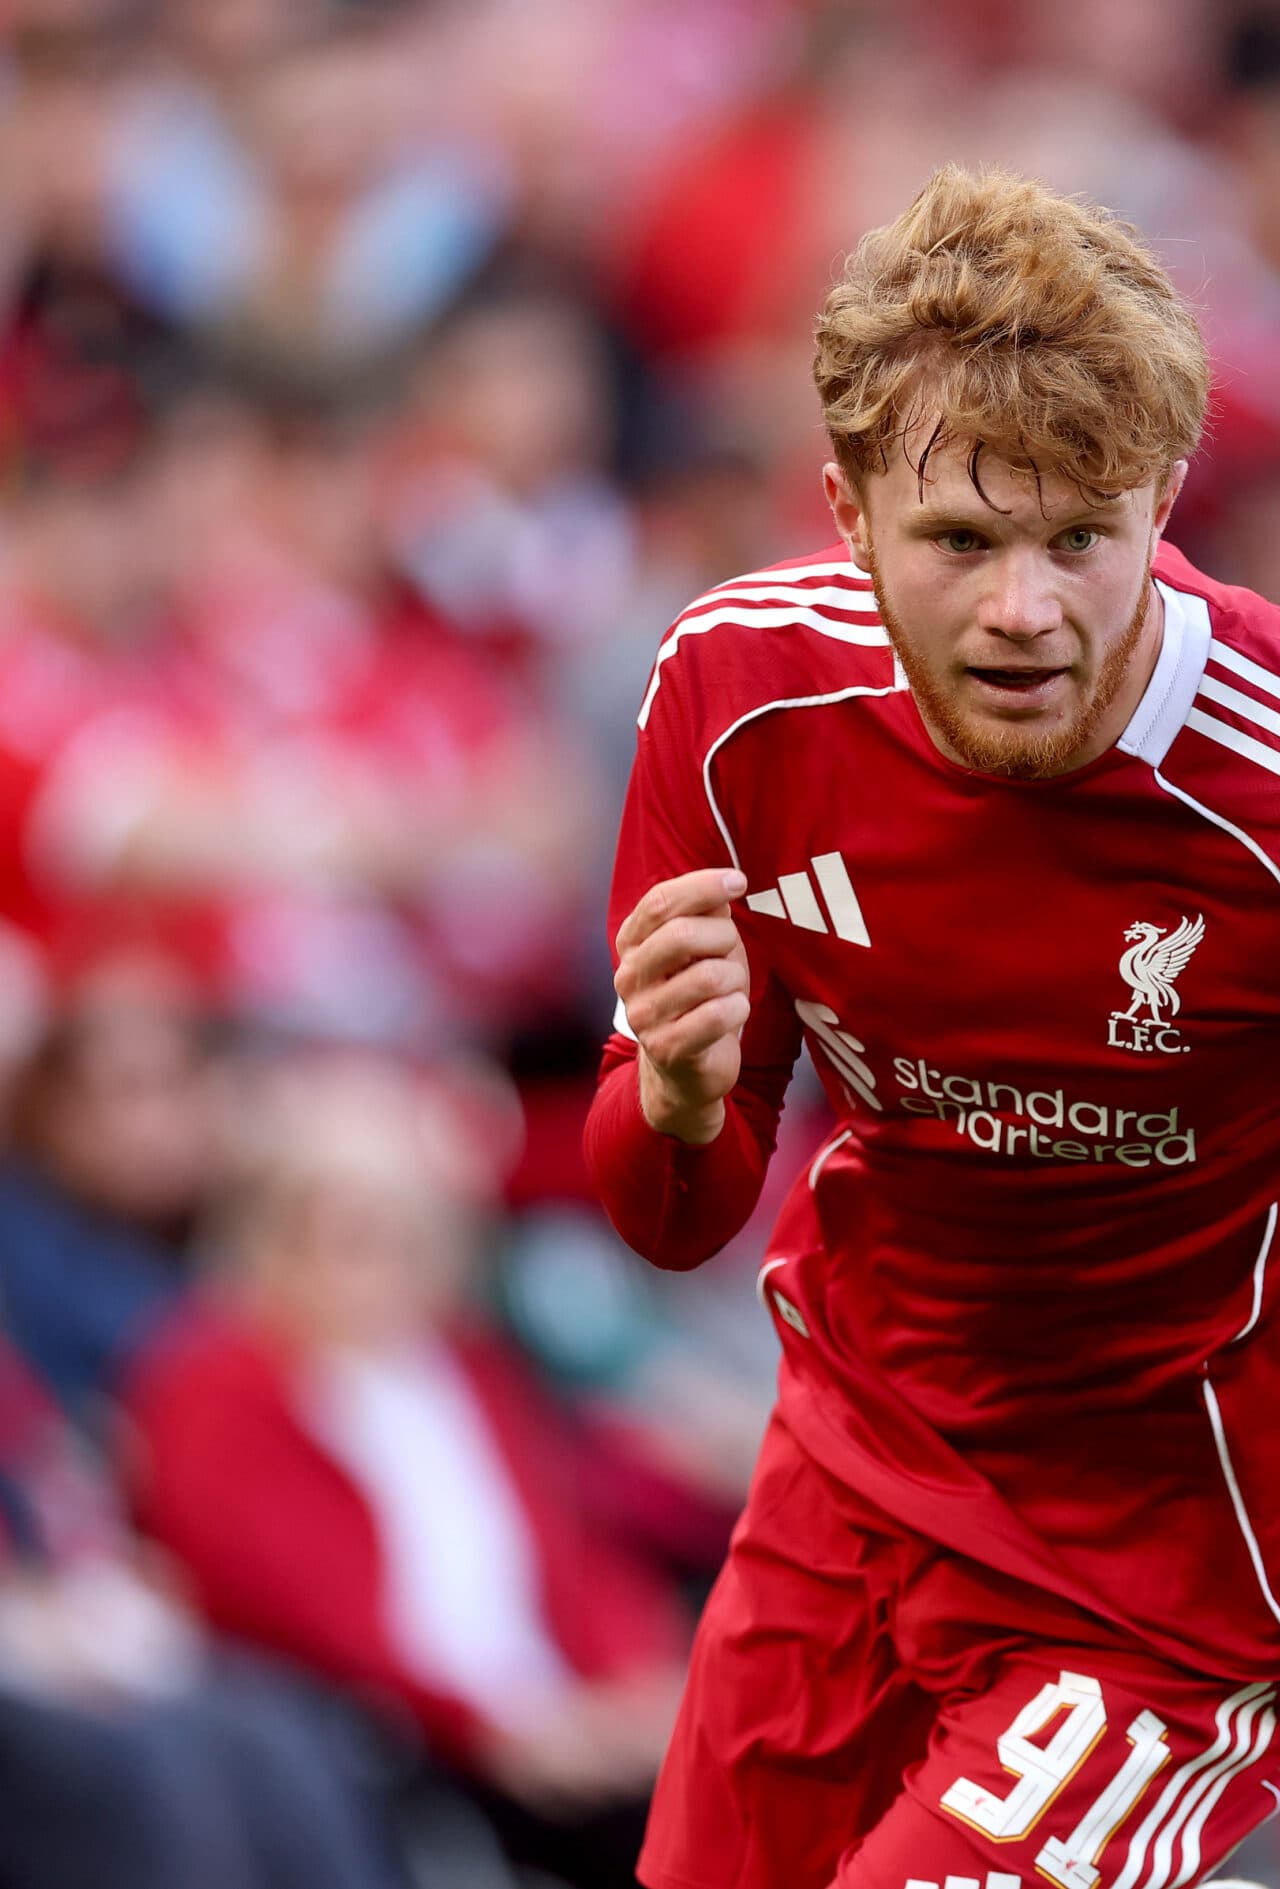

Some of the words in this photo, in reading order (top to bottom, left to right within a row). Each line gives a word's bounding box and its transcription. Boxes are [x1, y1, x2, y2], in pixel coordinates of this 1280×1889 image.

[1107, 1019, 1191, 1053] L.F.C.
[893, 1057, 1179, 1139] standard
[939, 1670, 1172, 1889] 91
